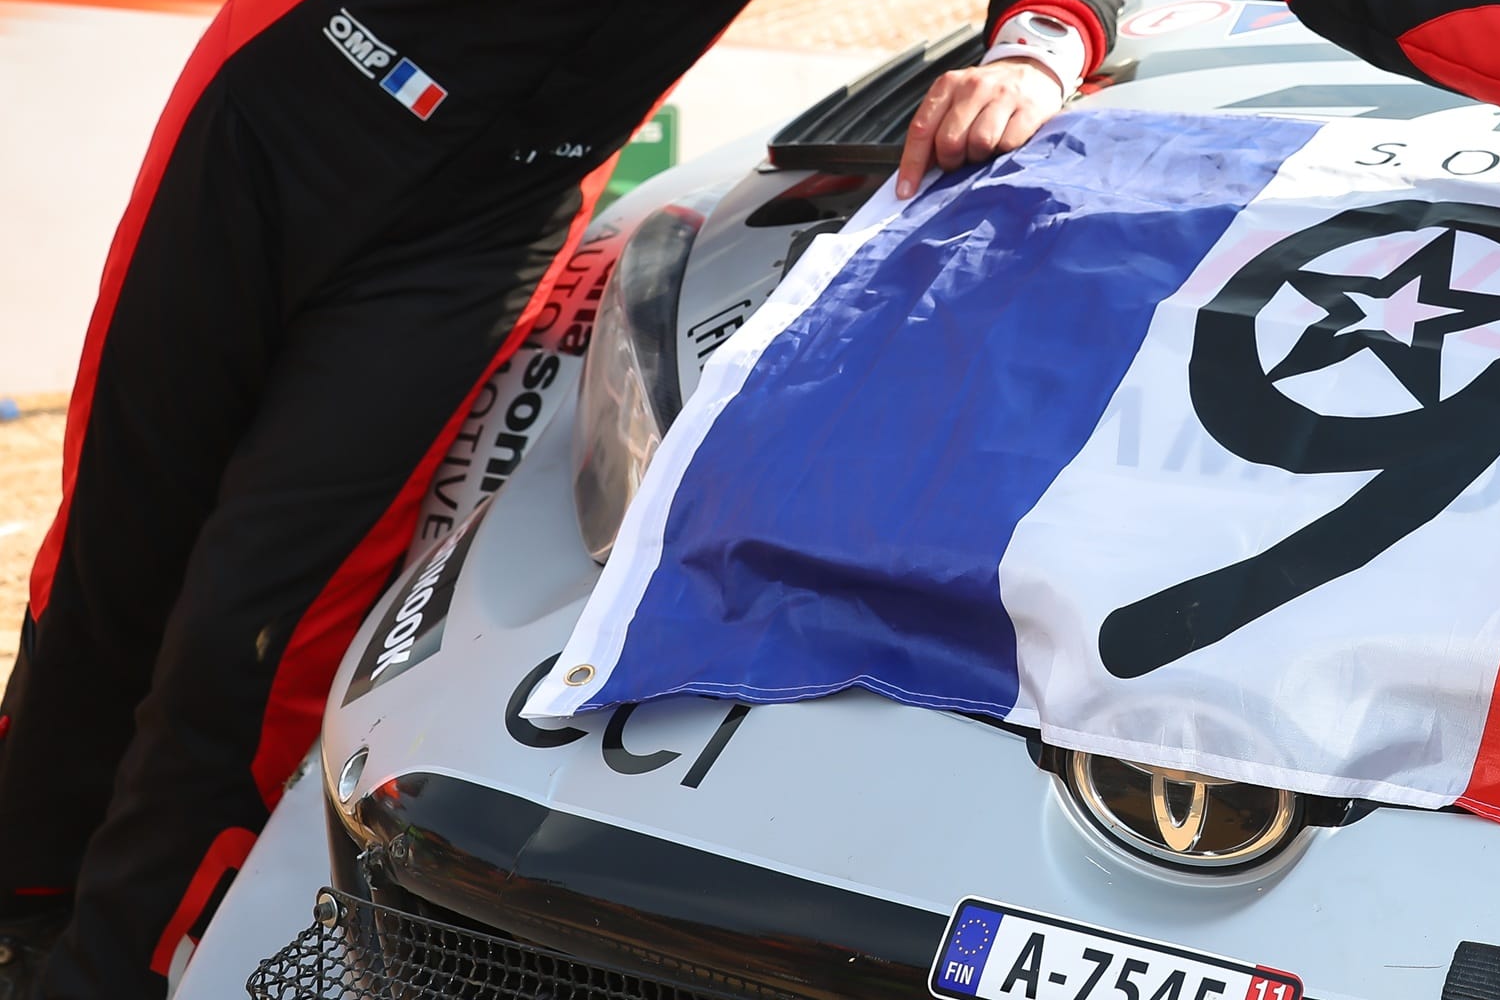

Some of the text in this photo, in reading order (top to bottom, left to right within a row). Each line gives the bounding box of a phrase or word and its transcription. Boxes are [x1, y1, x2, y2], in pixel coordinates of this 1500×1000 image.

[329, 14, 391, 69] OMP
[1355, 143, 1408, 167] S.
[944, 961, 976, 986] FIN
